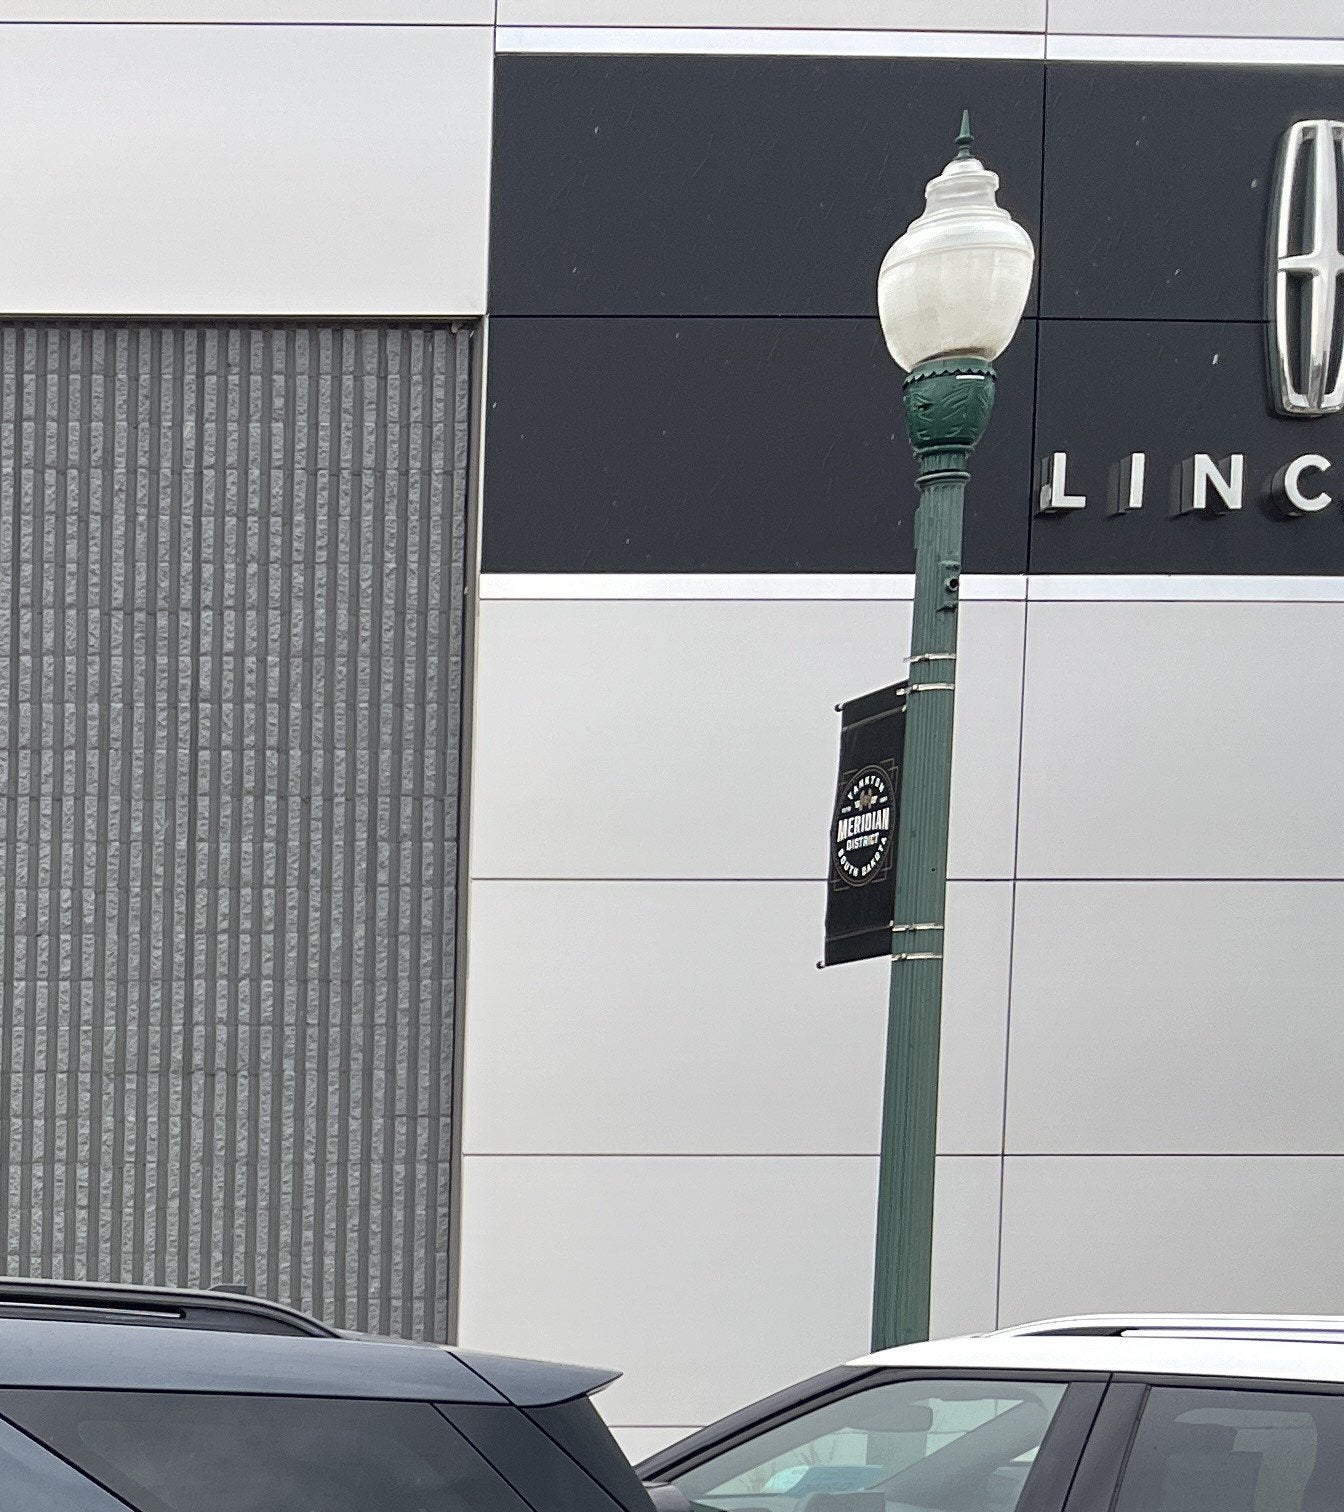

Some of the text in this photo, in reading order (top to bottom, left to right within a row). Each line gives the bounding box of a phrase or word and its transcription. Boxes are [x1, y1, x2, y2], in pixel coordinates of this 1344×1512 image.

[1042, 452, 1333, 512] LINC
[847, 775, 885, 800] YANKTON
[836, 806, 890, 843] MERIDIAN
[845, 831, 880, 852] DISTRICT
[837, 836, 888, 878] SOUTH DAKOTA
